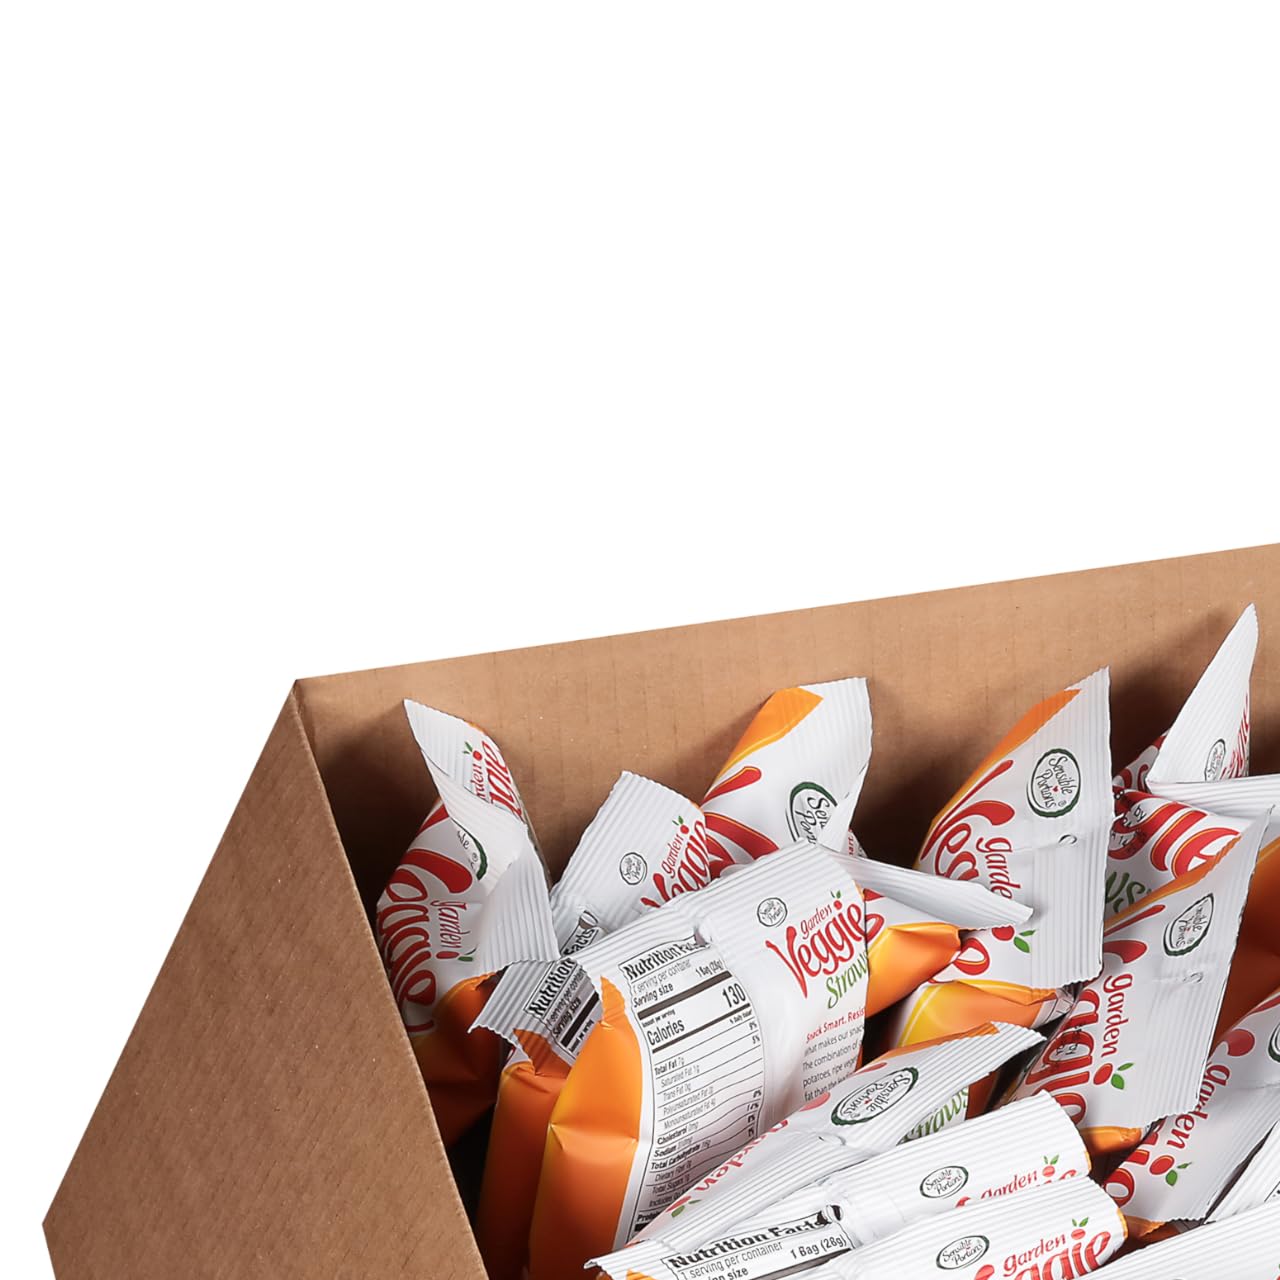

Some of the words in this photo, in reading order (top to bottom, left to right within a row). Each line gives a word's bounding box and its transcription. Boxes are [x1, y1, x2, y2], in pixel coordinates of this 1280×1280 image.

[1034, 768, 1058, 809] Portions
[1049, 754, 1077, 795] Sensible
[661, 833, 684, 878] garden
[975, 836, 1021, 900] garde
[800, 904, 832, 940] garden
[623, 944, 684, 980] Nutrition
[765, 903, 866, 999] Veggie
[722, 982, 746, 1008] 130
[826, 950, 867, 1009] Straw
[647, 1019, 686, 1046] Calories
[1101, 973, 1134, 1058] garden
[668, 1230, 768, 1269] Nutrition
[689, 1260, 725, 1278] serving
[724, 1256, 741, 1271] per
[742, 1241, 784, 1262] container
[799, 1244, 819, 1258] Bag
[820, 1234, 847, 1253] (28g)
[941, 1238, 973, 1262] Sensible
[950, 1243, 985, 1267] Portions
[1002, 1234, 1067, 1278] garden
